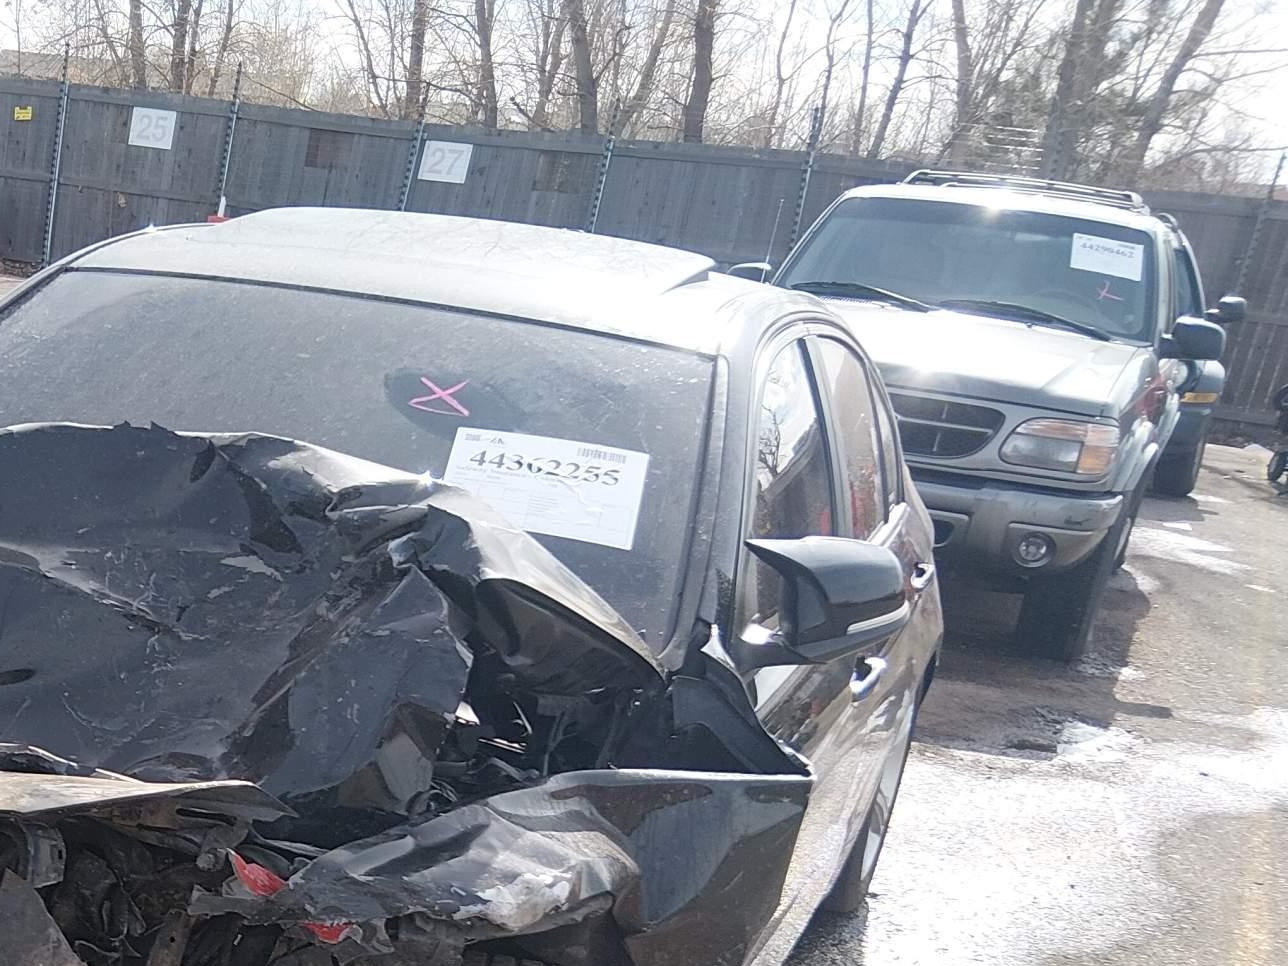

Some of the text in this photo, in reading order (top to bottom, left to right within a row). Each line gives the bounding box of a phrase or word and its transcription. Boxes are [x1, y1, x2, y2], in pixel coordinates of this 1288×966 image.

[136, 114, 169, 142] 25
[427, 147, 464, 174] 27
[469, 449, 622, 487] 44362255
